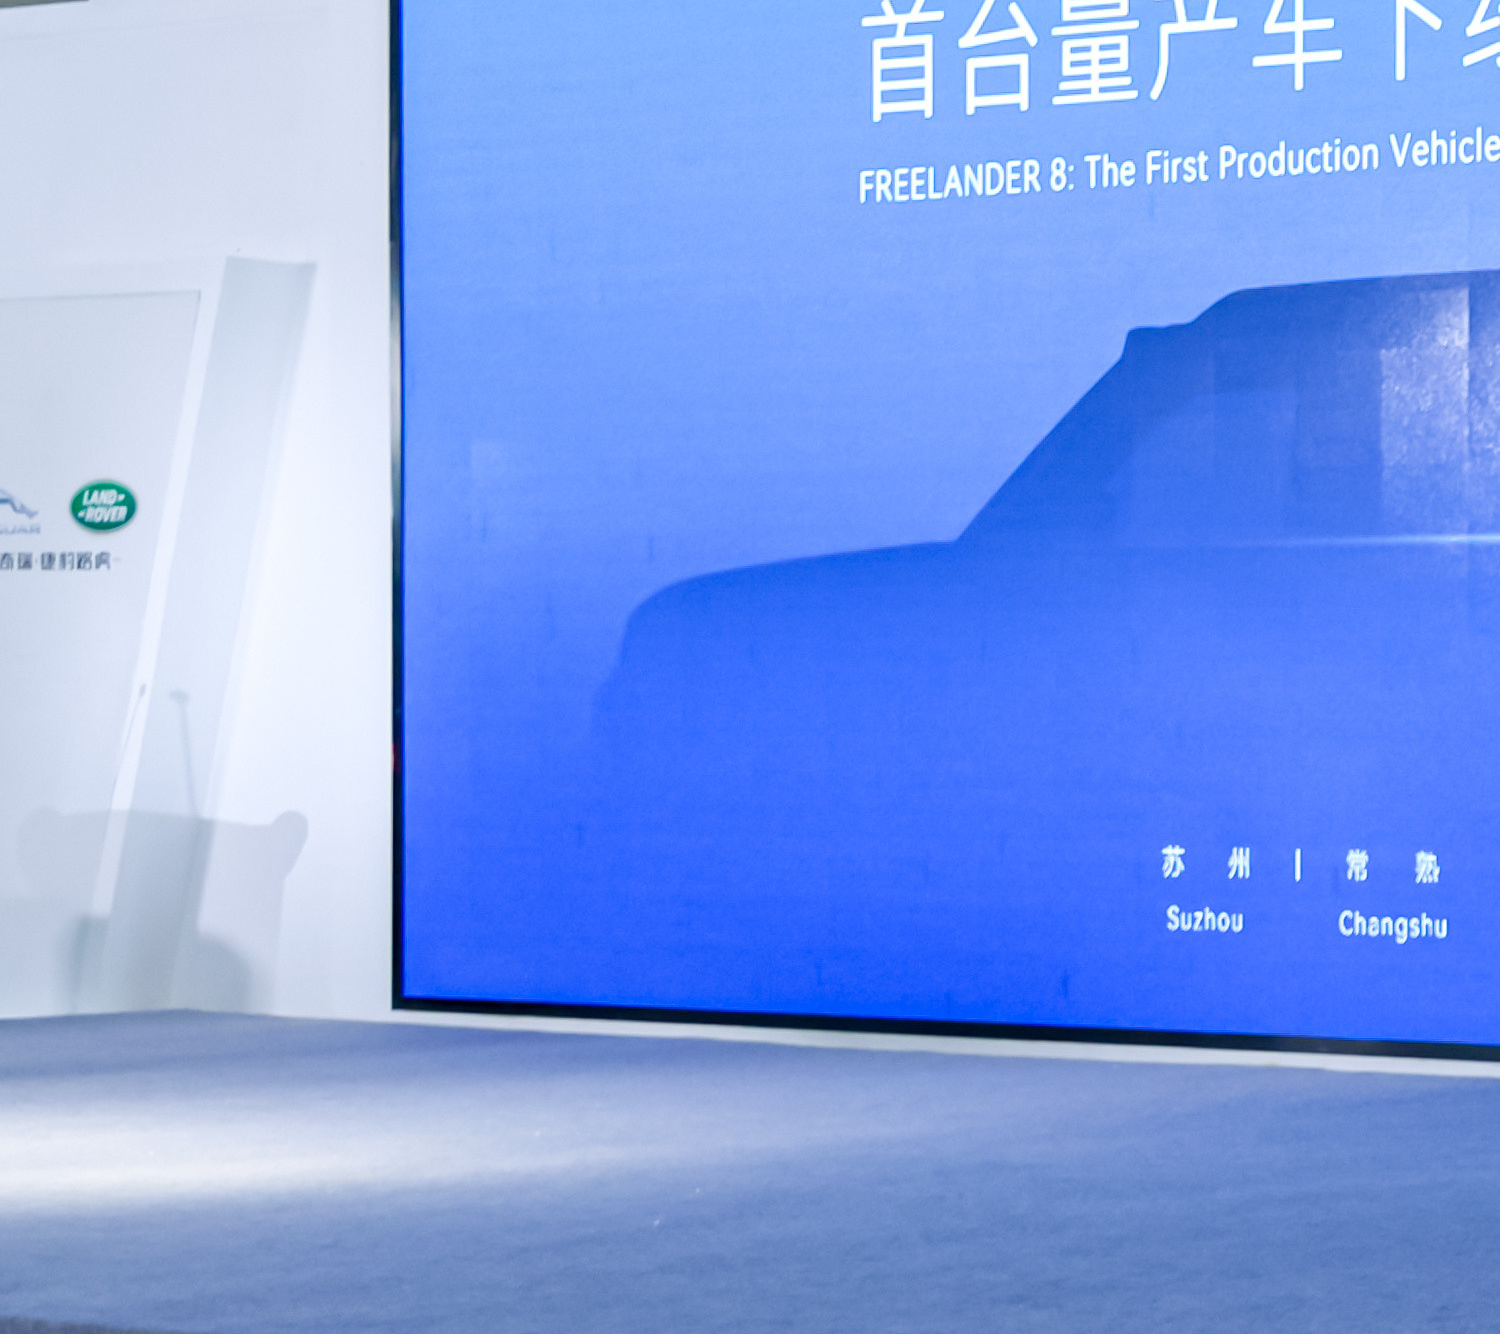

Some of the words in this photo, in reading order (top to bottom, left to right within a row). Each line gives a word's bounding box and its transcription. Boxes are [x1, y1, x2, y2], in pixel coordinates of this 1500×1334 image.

[859, 159, 1041, 204] FREELANDER
[1050, 157, 1074, 192] 8:
[1083, 153, 1136, 189] The
[1146, 150, 1209, 185] First
[1219, 138, 1379, 180] Production
[1161, 844, 1250, 879] 苏州
[1166, 904, 1243, 933] Suzhou
[1338, 909, 1448, 945] Changshu
